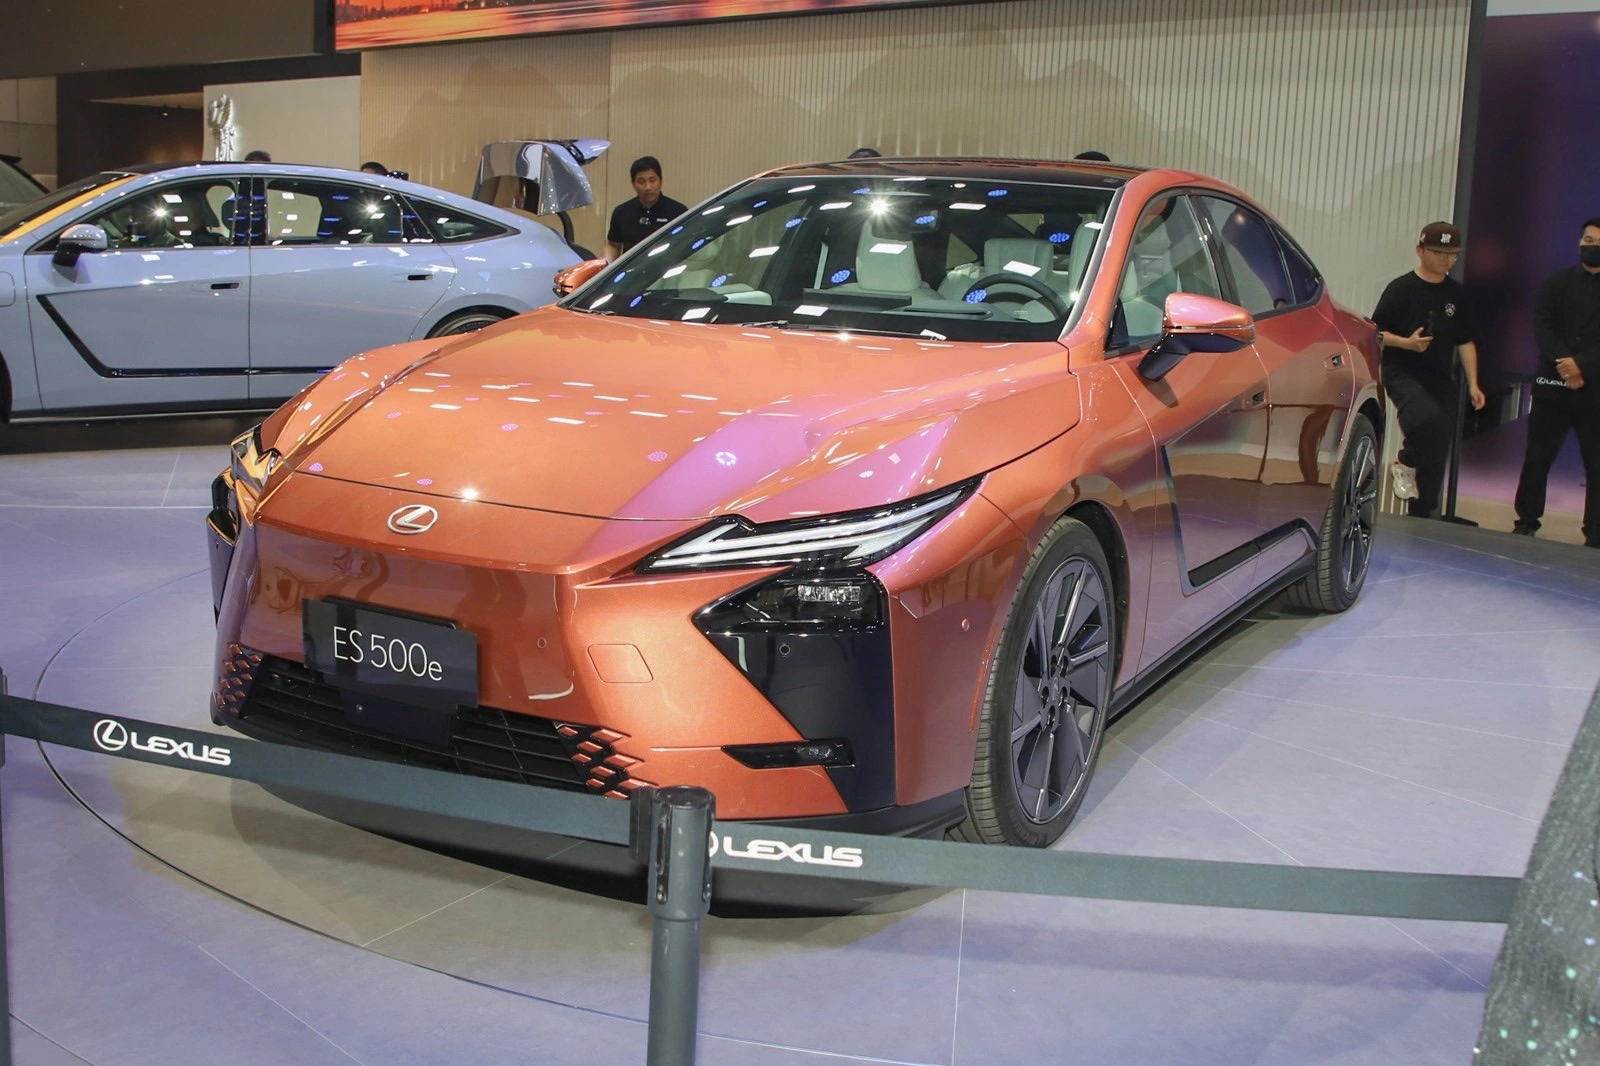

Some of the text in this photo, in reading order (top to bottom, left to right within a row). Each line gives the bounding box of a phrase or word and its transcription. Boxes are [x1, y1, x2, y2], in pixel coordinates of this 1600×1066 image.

[1546, 379, 1567, 387] LEXU
[333, 625, 443, 681] ES 500e
[130, 731, 232, 766] LEXUS
[723, 836, 863, 868] LEXUS
